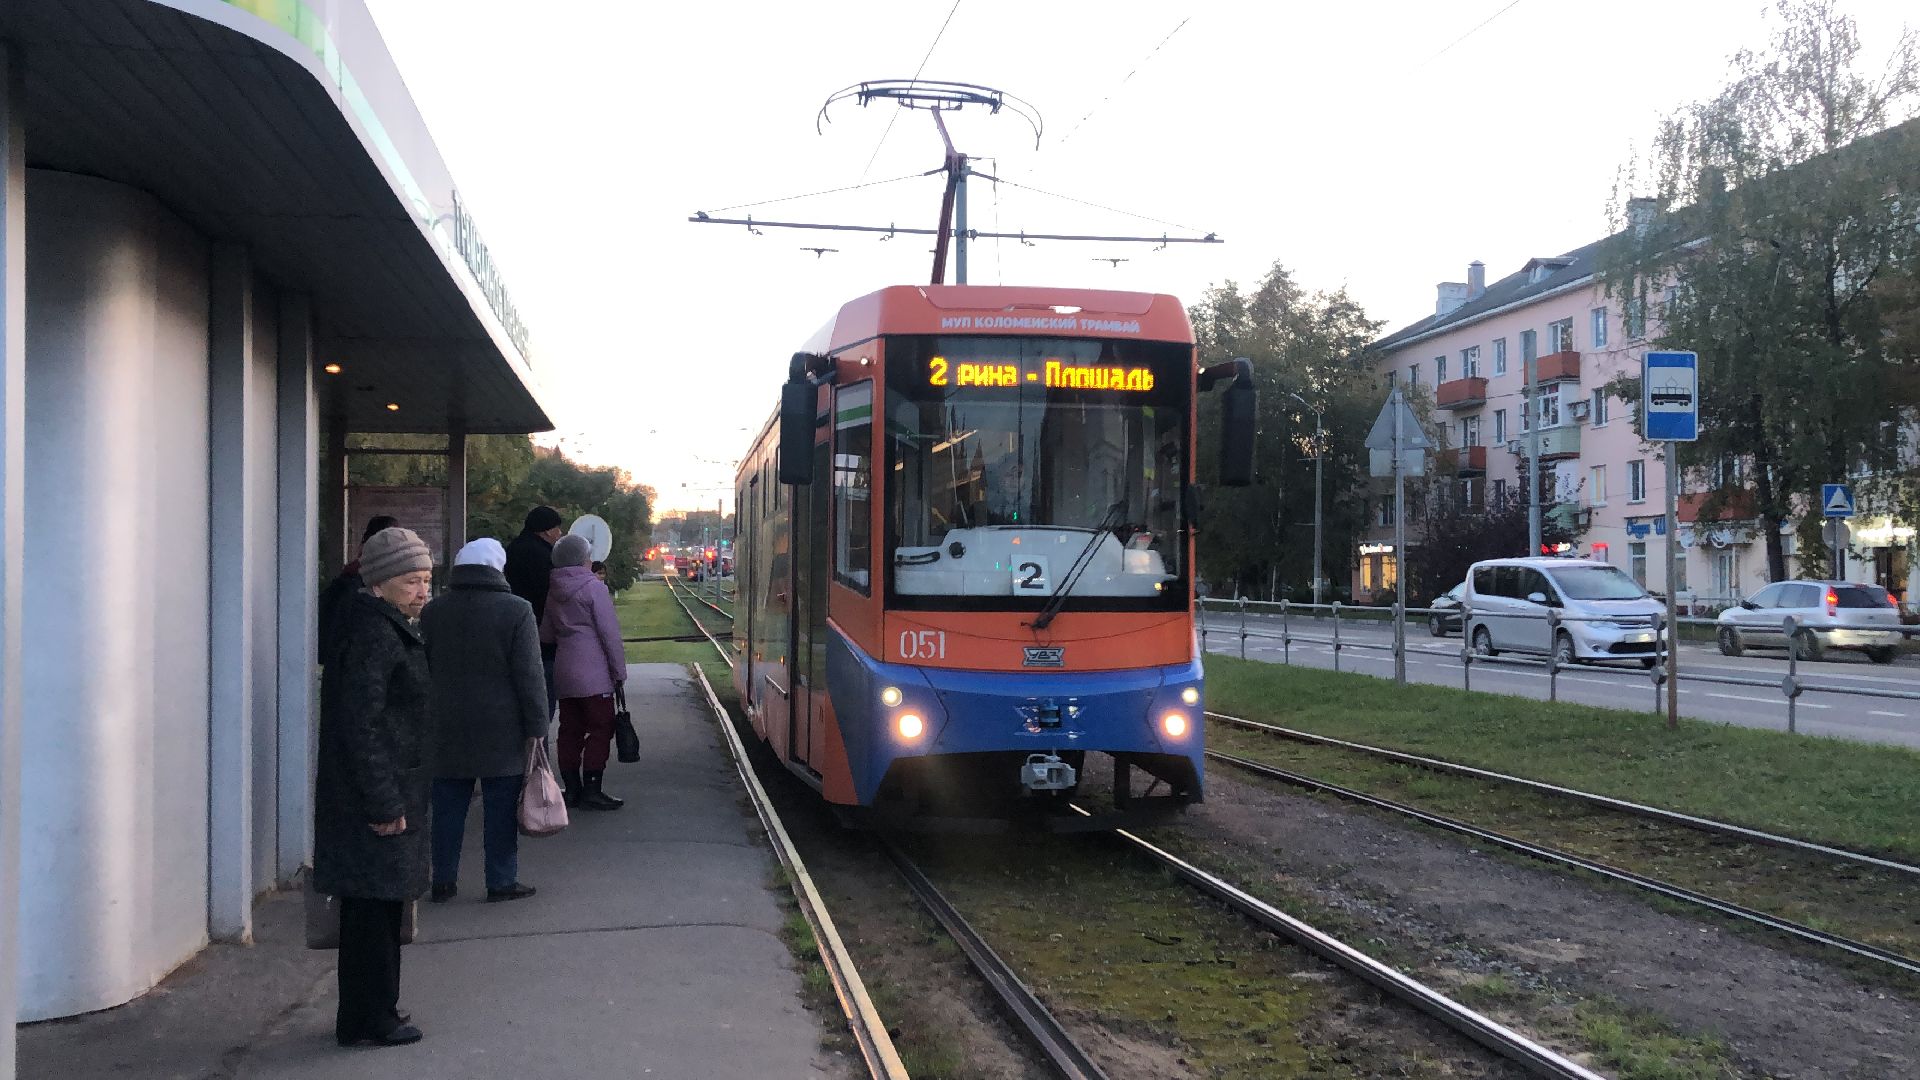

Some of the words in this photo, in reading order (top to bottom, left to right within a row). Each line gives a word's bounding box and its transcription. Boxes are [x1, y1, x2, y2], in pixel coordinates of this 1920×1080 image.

[942, 316, 971, 329] МУП
[1080, 318, 1140, 333] ТРАМВАЙ
[929, 357, 948, 386] 2
[957, 363, 1018, 387] рина
[1026, 372, 1038, 382] -
[1019, 561, 1045, 589] 2
[900, 630, 945, 659] 051
